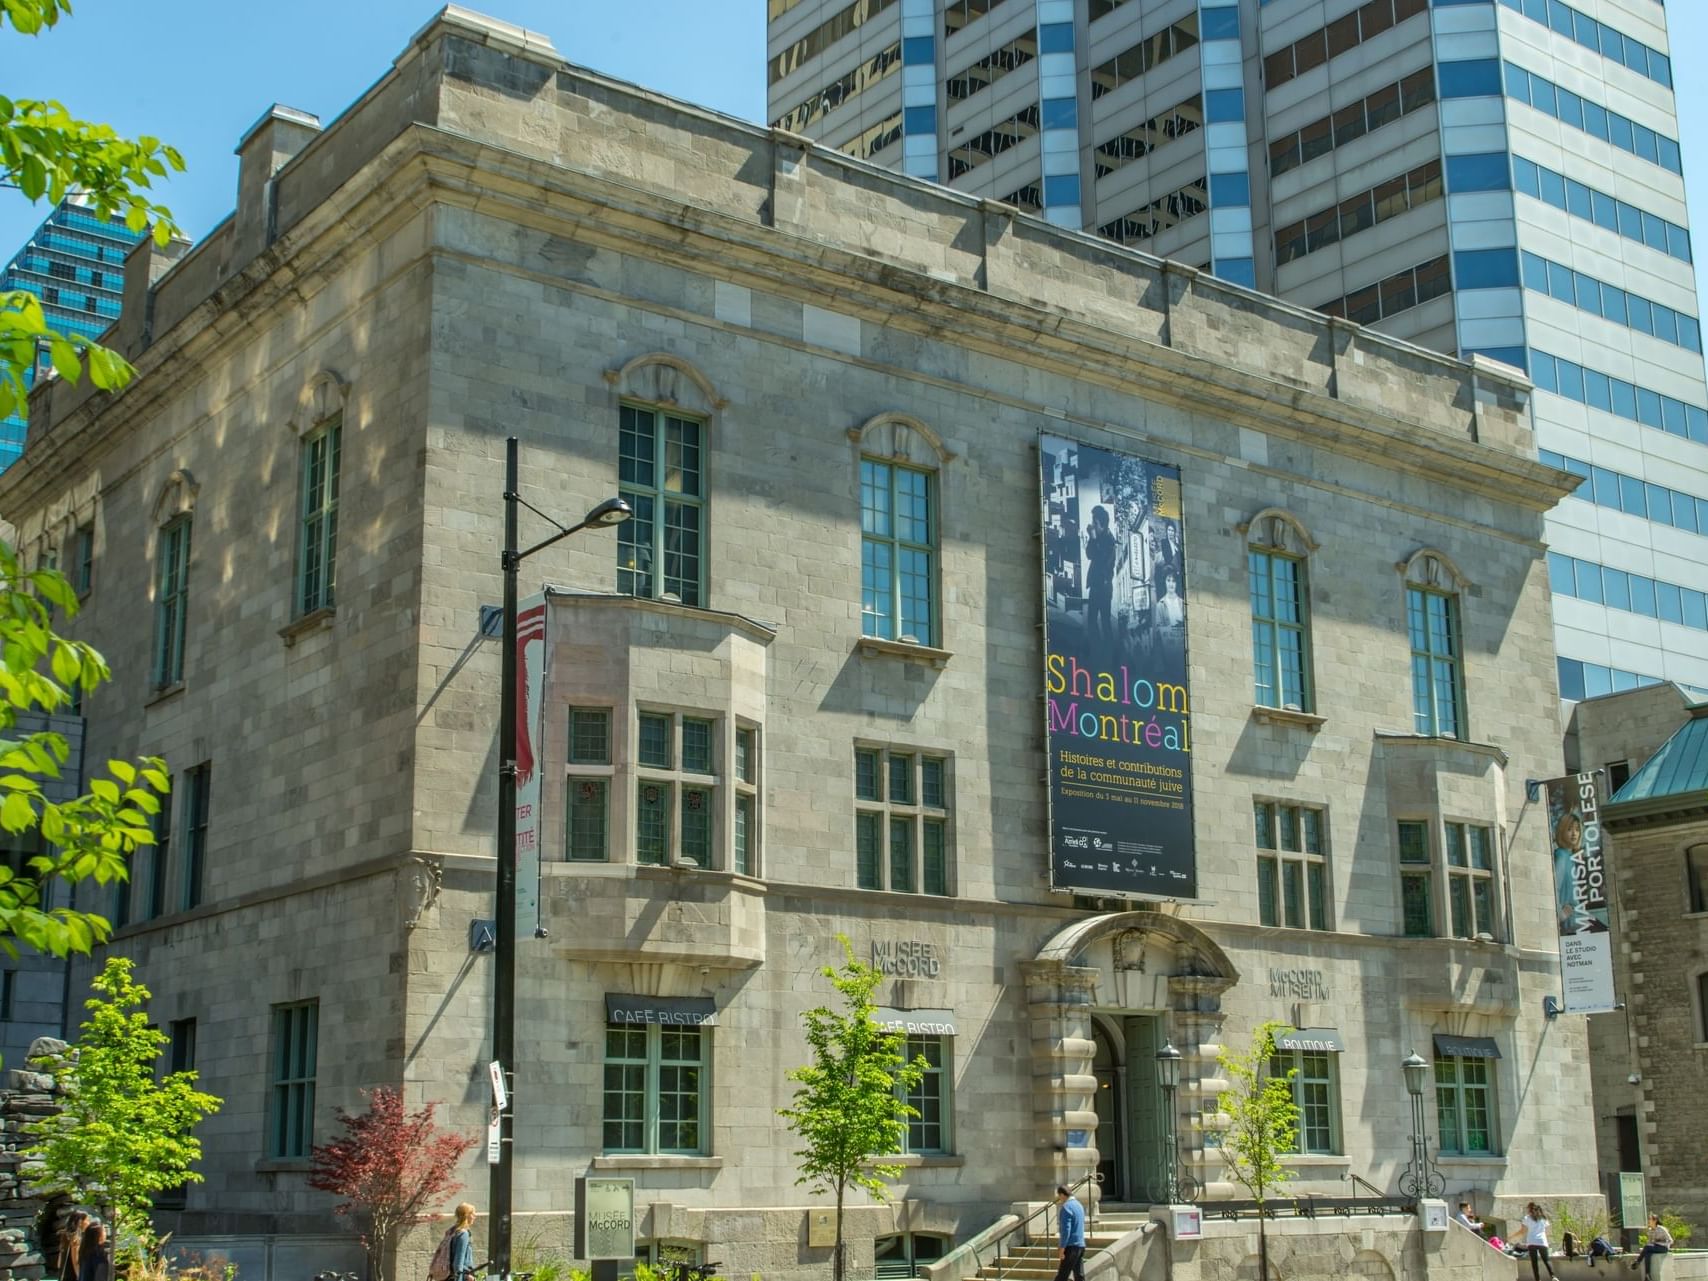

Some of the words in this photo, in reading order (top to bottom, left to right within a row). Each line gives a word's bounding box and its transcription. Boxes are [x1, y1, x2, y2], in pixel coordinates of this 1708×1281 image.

[1047, 654, 1190, 714] Shalom
[1048, 699, 1191, 752] Montréal
[1060, 750, 1104, 767] Histoires
[1106, 759, 1116, 769] et
[1119, 761, 1183, 778] contributions
[1060, 766, 1074, 777] de
[1077, 767, 1087, 780] la
[1090, 771, 1157, 789] communauté
[1158, 778, 1183, 792] juive
[1095, 791, 1104, 800] du
[1577, 770, 1604, 903] PORTOLESE
[1570, 849, 1596, 935] MARISA
[1565, 940, 1582, 948] DANS
[1575, 945, 1597, 954] STUDIO
[872, 956, 941, 979] McCORD
[1567, 960, 1593, 968] NOTMAN
[1269, 967, 1322, 985] McCORD
[1270, 983, 1330, 1000] MUSEUM
[658, 1011, 714, 1026] BISTRO
[907, 1022, 955, 1035] BISTRO
[1283, 1039, 1335, 1051] BOUTIQUE
[589, 1219, 631, 1231] McCORD
